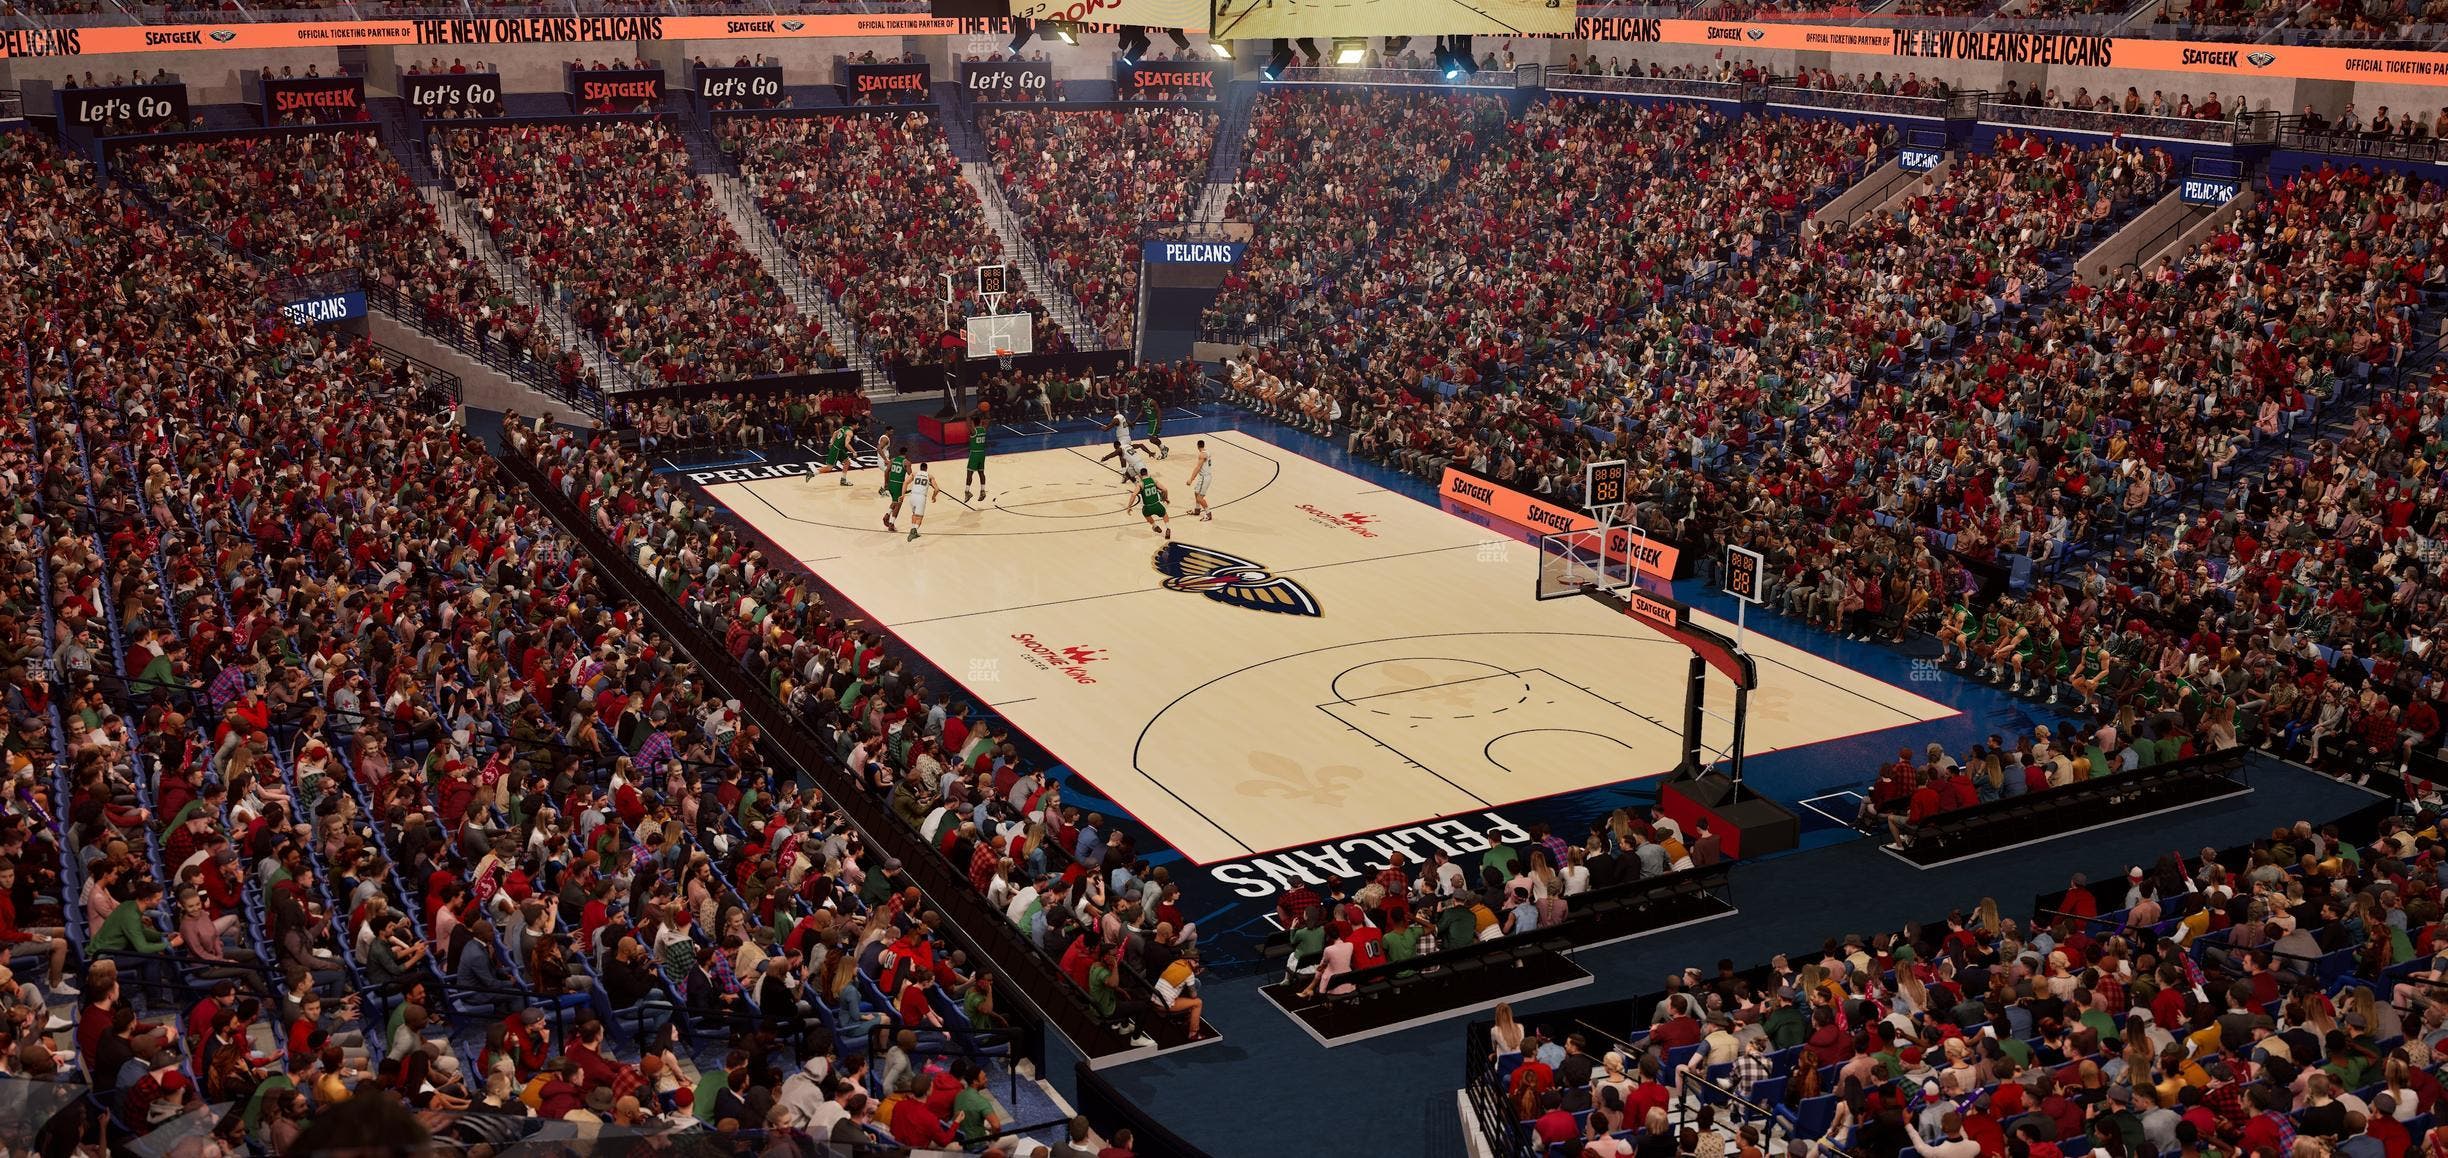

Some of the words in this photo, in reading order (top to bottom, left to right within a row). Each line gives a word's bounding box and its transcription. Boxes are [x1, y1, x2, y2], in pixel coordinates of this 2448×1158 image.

[298, 30, 329, 39] OFFICIAL
[331, 28, 366, 38] TICKETING
[368, 28, 400, 37] PARTNER
[401, 28, 411, 36] OF
[413, 19, 448, 44] THE
[451, 19, 490, 43] NEW
[495, 18, 577, 43] ORLEANS
[580, 17, 662, 41] PELICANS
[727, 20, 775, 33] SEATGEEK
[858, 21, 885, 29] OFFICIAL
[886, 20, 917, 29] TICKETING
[919, 20, 944, 28] PARTNER
[946, 19, 954, 27] OF
[1592, 17, 1661, 42] PELICANS
[1707, 26, 1742, 41] SEATGEEK
[146, 31, 202, 45] SEATGEEK
[1806, 33, 1829, 43] OFFICIAL
[1830, 34, 1857, 45] TICKETING
[1858, 35, 1882, 46] PARTNER
[1883, 37, 1891, 46] OF
[1893, 29, 1918, 56] THE
[1920, 30, 1954, 58] NEW
[1962, 31, 2029, 62] ORLEANS
[2031, 34, 2112, 67] PELICANS
[2182, 48, 2238, 68] SEATGEEK
[2345, 58, 2383, 72] OFFICIAL
[2386, 60, 2431, 75] TICKETING
[584, 80, 657, 99] SEATGEEK
[703, 78, 746, 97] Let's
[752, 77, 778, 96] Go
[857, 73, 923, 92] SEATGEEK
[969, 71, 1013, 89] Let's
[1019, 71, 1046, 89] Go
[1134, 71, 1215, 88] SEATGEEK
[276, 88, 356, 111] SEATGEEK
[413, 85, 460, 105] Let's
[467, 84, 495, 104] Go
[80, 98, 131, 122] Let's
[138, 96, 172, 118] Go
[1902, 151, 1939, 168] PELICANS
[2185, 181, 2233, 203] PELICANS
[1166, 244, 1231, 263] PELICANS
[1452, 477, 1494, 506] SEATGEEK
[1597, 481, 1618, 501] 88
[1527, 504, 1574, 533] SEATGEEK
[1733, 569, 1749, 594] 88
[1636, 599, 1671, 622] SEATGEEK
[1211, 812, 1531, 897] PELICANS
